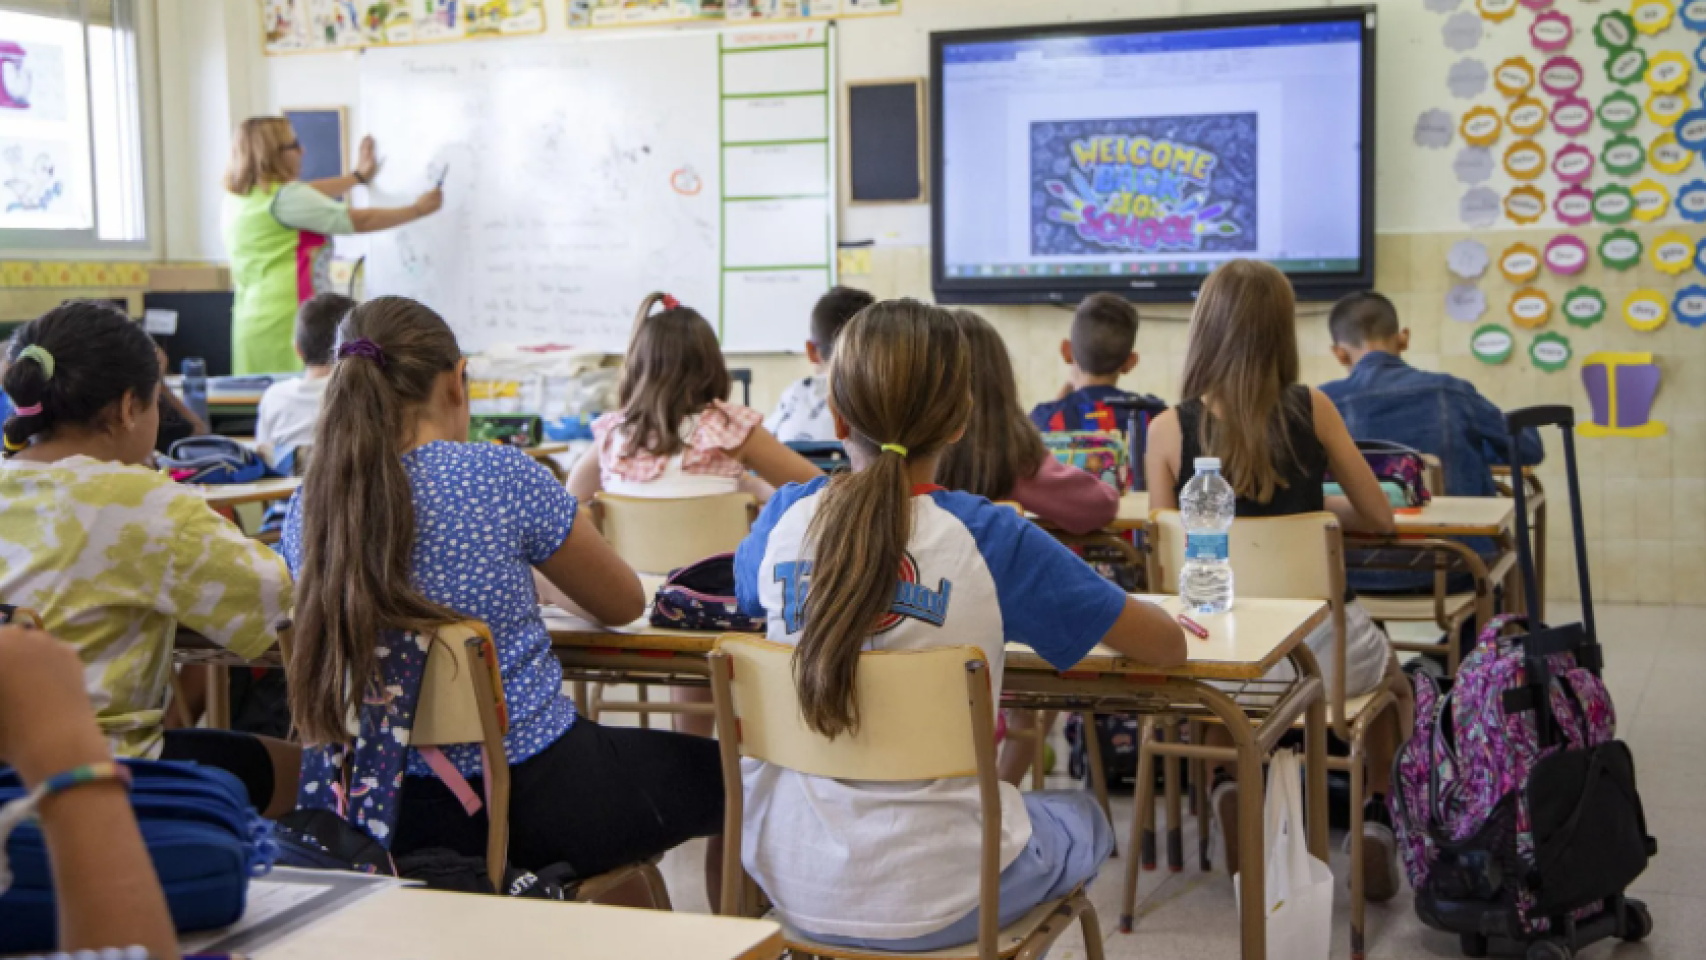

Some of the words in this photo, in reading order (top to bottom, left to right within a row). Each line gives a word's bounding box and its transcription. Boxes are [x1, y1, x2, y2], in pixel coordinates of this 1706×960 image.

[1073, 137, 1213, 179] WELCOME
[1095, 164, 1182, 199] BACK
[1119, 192, 1151, 218] TO
[1079, 205, 1195, 248] SCHOOL
